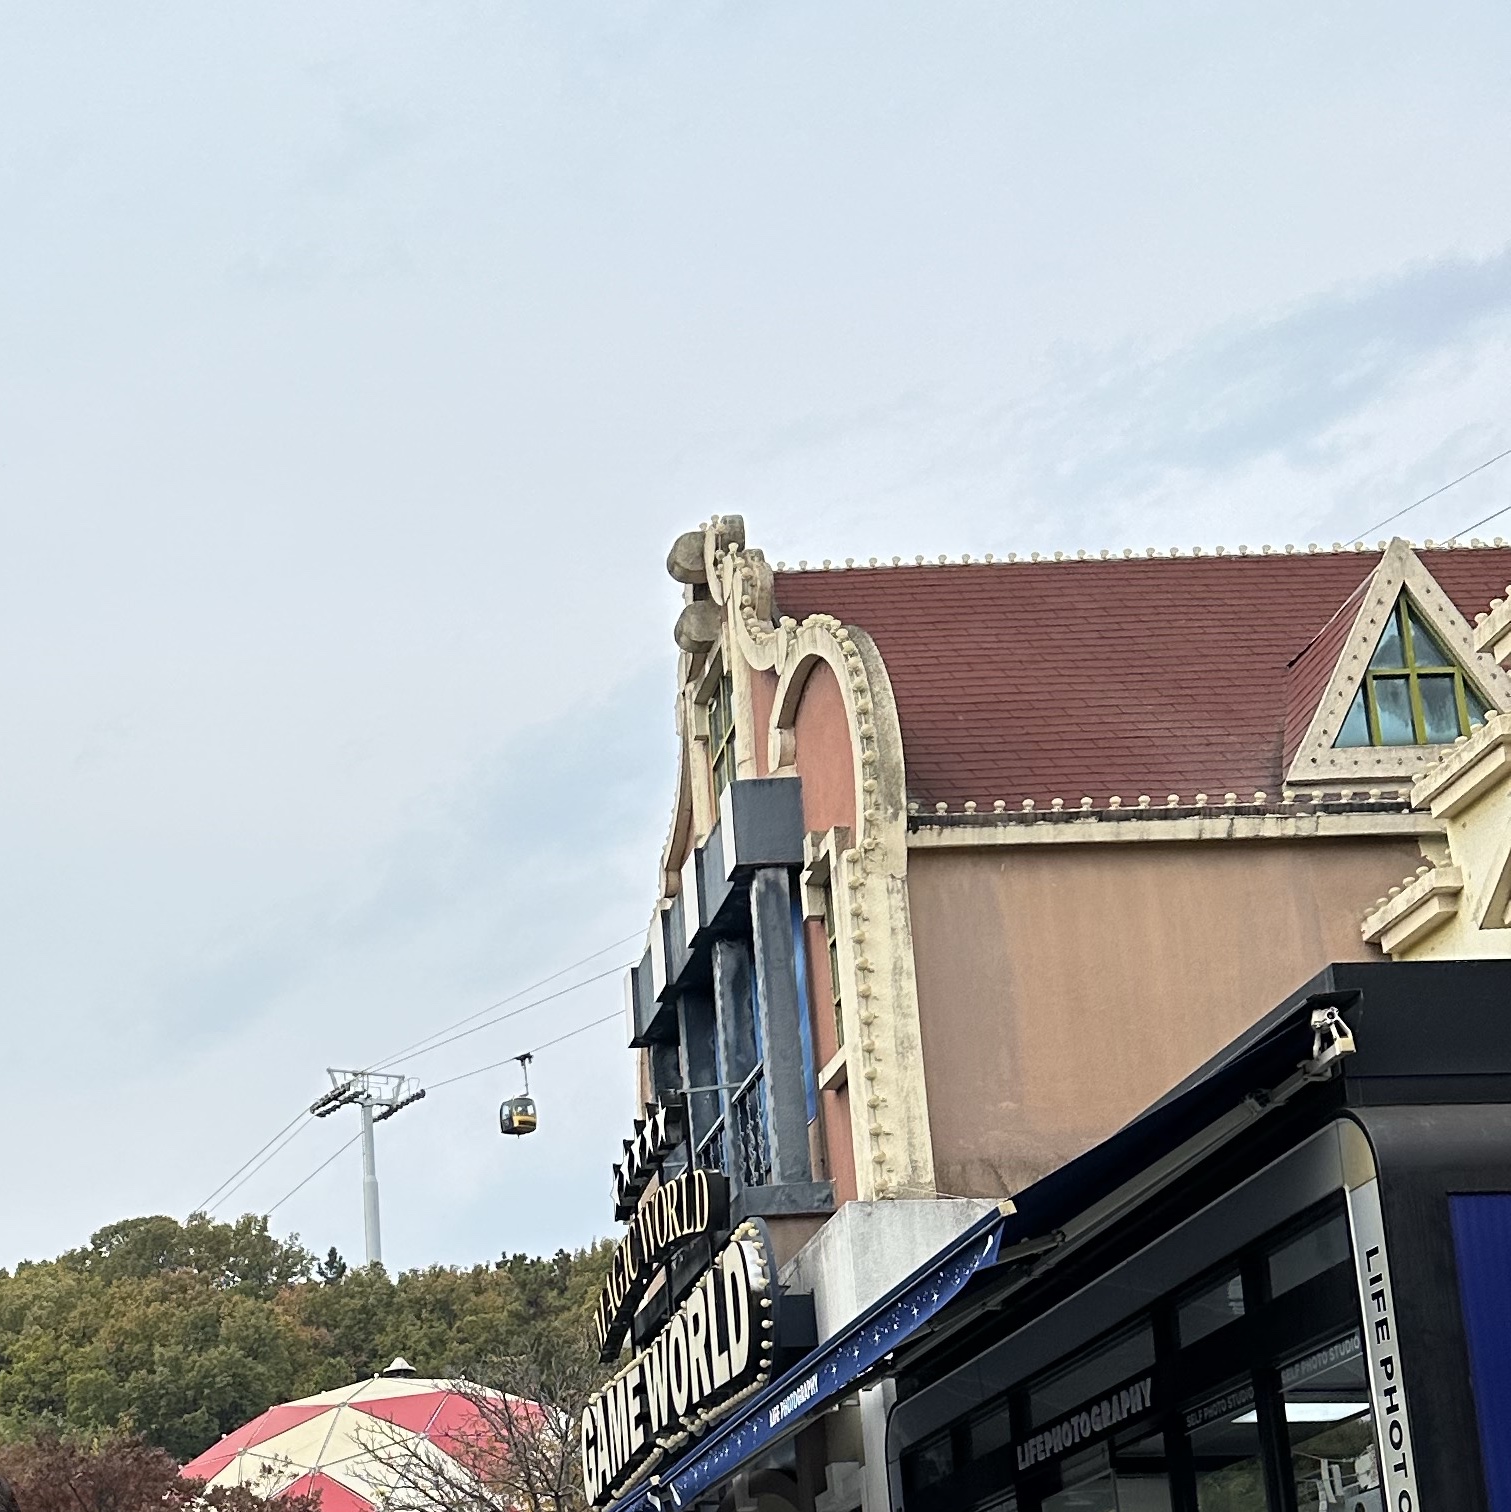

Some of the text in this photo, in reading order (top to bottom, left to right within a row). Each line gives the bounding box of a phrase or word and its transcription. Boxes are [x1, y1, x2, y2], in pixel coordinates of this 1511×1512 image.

[592, 1168, 709, 1347] MAGIC WORLD
[1365, 1245, 1391, 1345] LIFE
[581, 1241, 750, 1507] GAME WORLD
[1203, 1399, 1227, 1421] PHOTO
[1227, 1385, 1255, 1409] STUDIO
[1300, 1351, 1328, 1376] PHOTO
[1328, 1335, 1360, 1361] STUDIO
